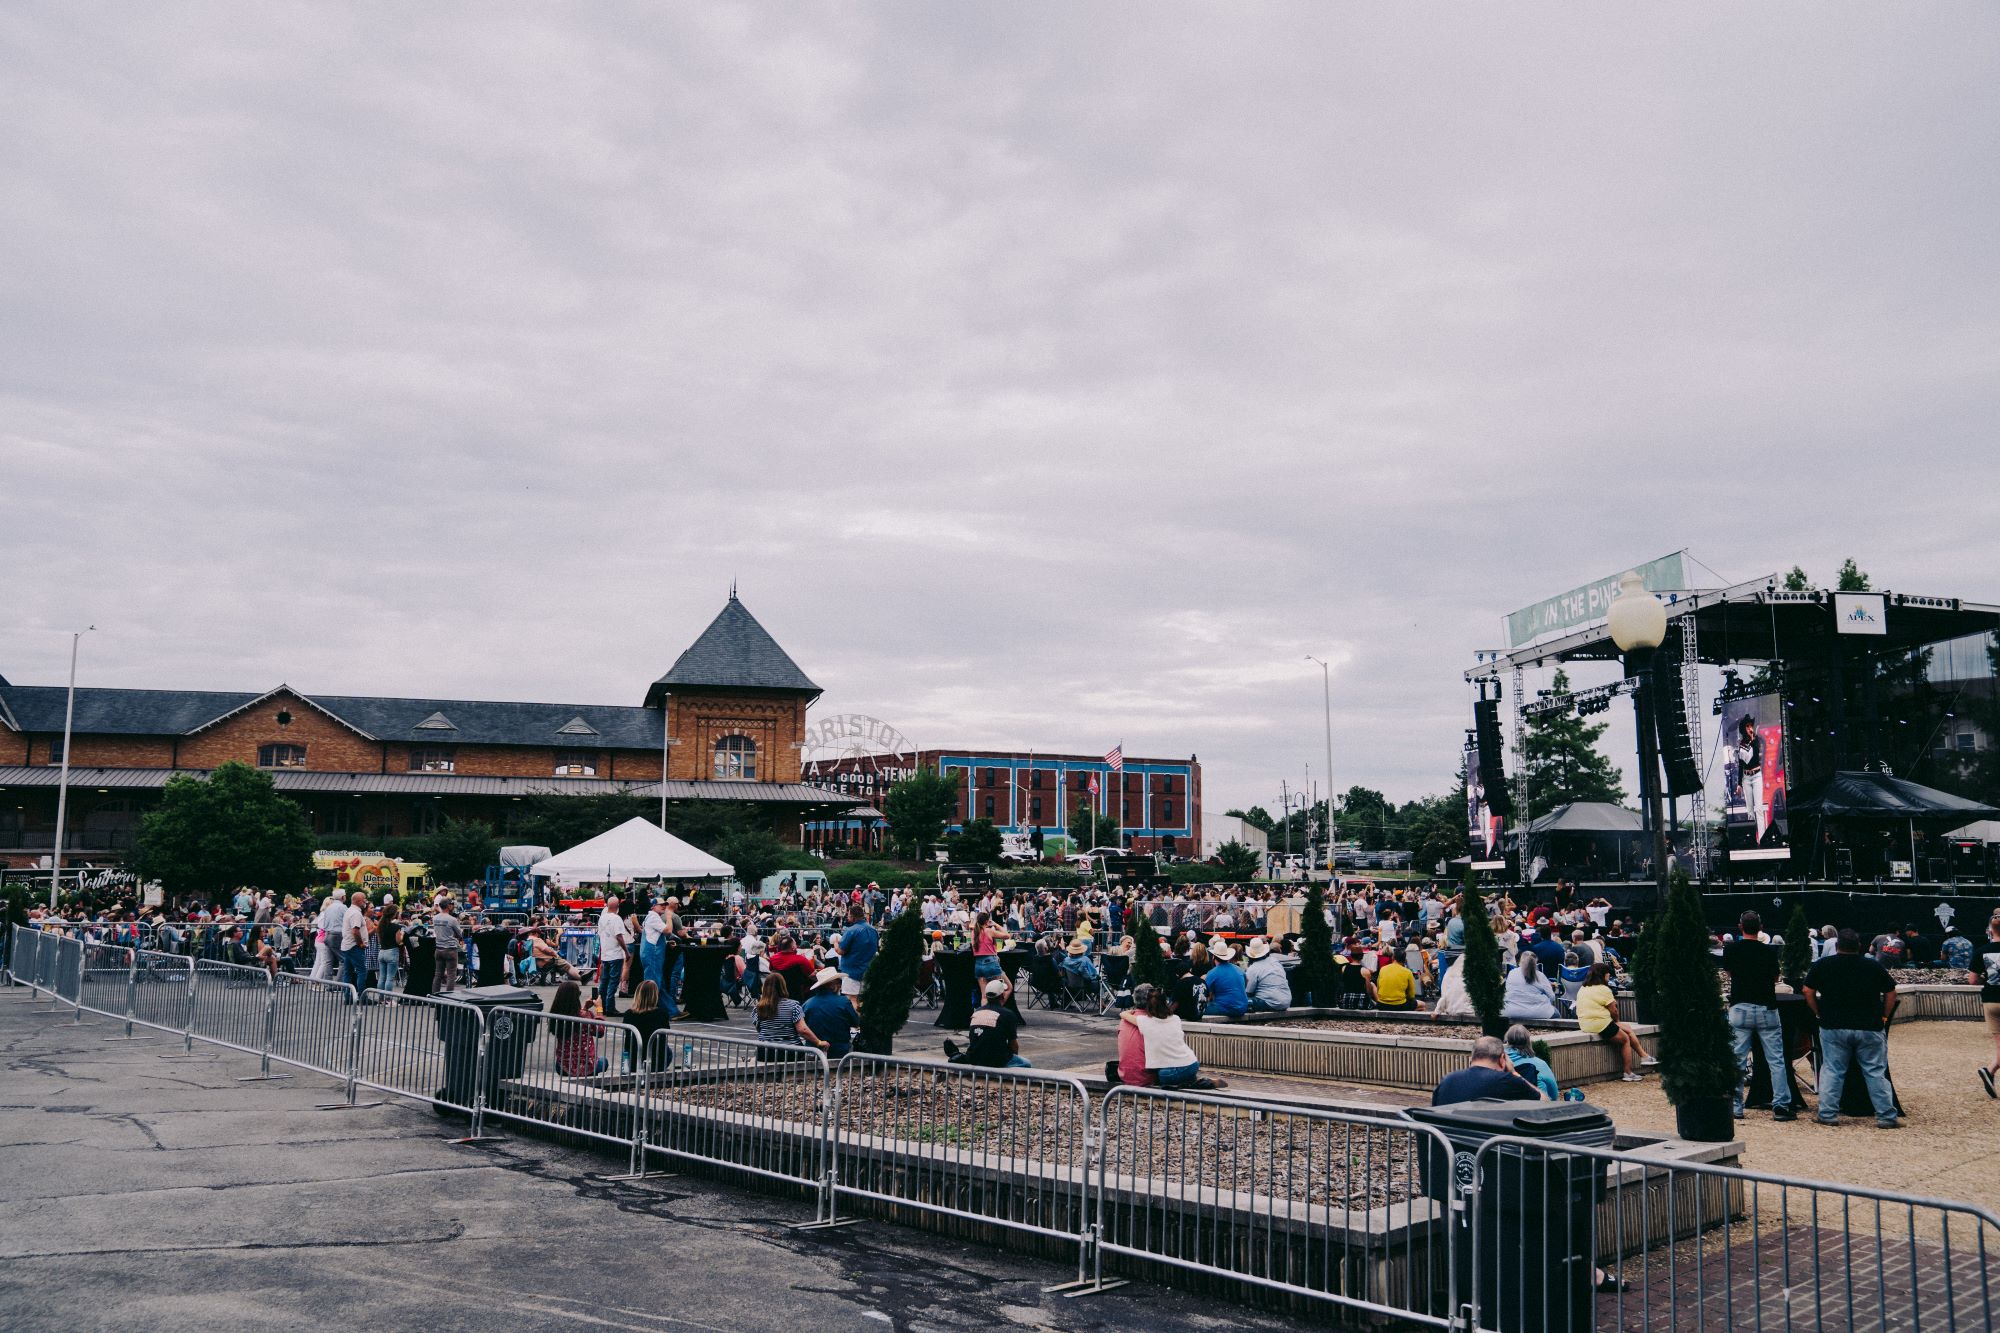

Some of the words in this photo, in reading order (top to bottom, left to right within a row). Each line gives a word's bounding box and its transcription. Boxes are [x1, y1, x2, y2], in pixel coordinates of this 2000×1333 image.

[1544, 600, 1558, 626] IN
[1561, 592, 1585, 620] THE
[806, 714, 904, 762] BRISTOL
[853, 763, 860, 773] A
[841, 773, 873, 785] GOOD
[858, 785, 873, 796] TO
[78, 868, 136, 890] Southern
